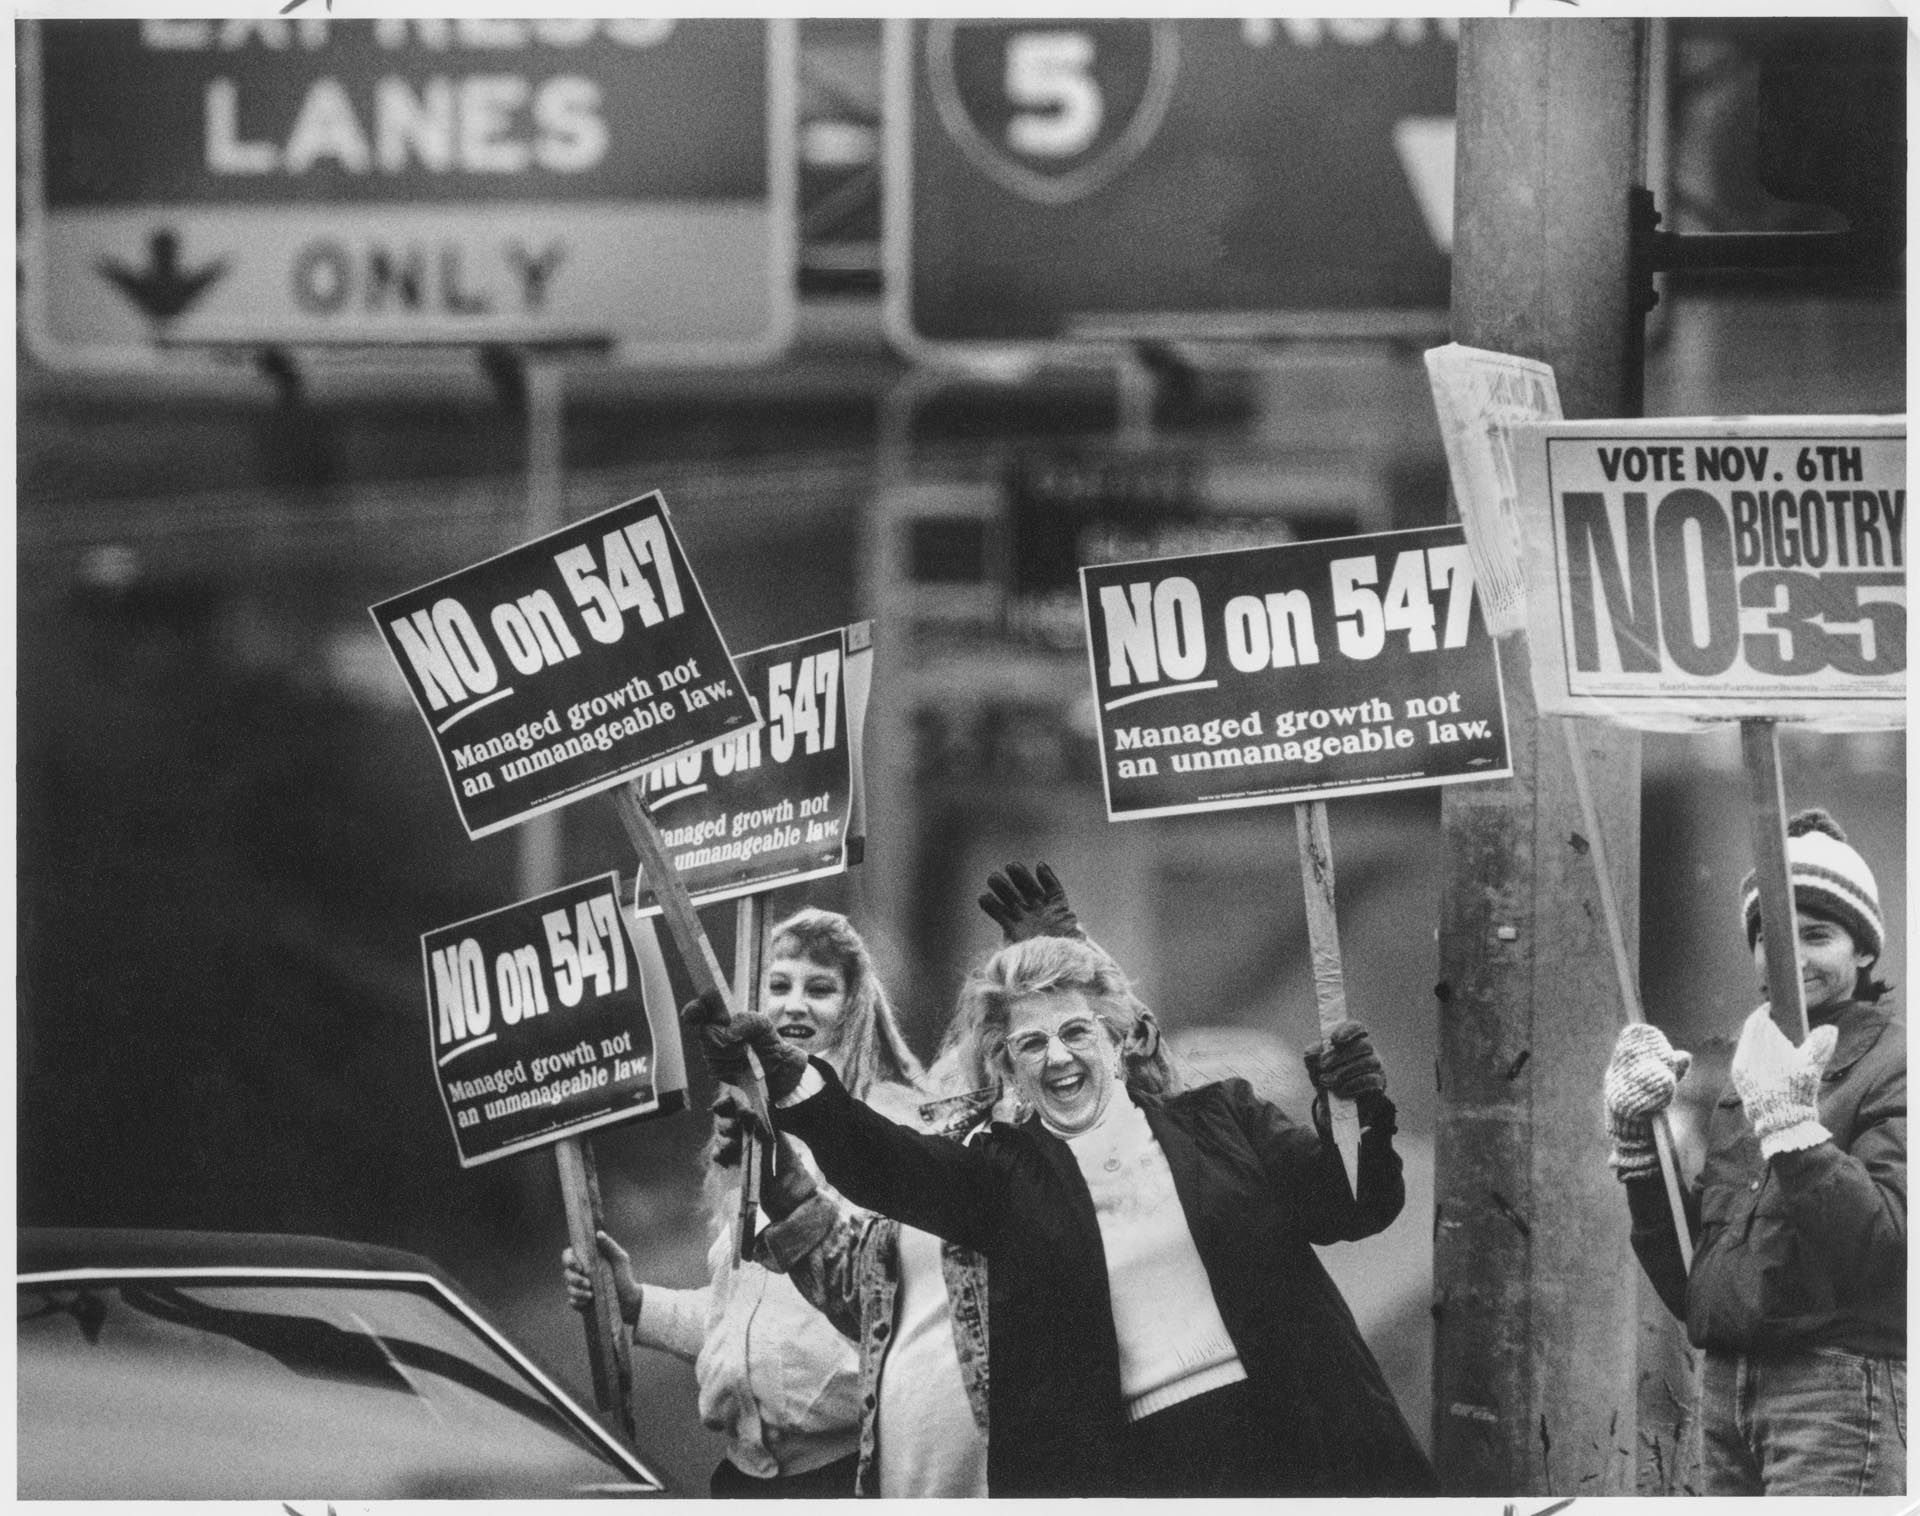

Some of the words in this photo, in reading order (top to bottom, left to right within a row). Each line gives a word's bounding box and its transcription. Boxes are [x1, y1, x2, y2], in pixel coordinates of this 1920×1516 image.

[205, 77, 609, 173] LANES
[1006, 32, 1101, 157] 5
[292, 237, 566, 316] ONLY
[1597, 446, 1686, 482] VOTE
[1695, 446, 1784, 482] NOV.
[1796, 446, 1863, 482] 6TH
[1731, 489, 1906, 568] BIGOTRY
[391, 598, 498, 711] NO
[491, 589, 581, 675] on
[554, 515, 685, 644] 547
[1100, 577, 1207, 686] NO
[1224, 589, 1320, 673] on
[1330, 544, 1475, 661] 547
[1562, 488, 1740, 677] NO
[1738, 570, 1907, 677] 35
[452, 710, 561, 771] Managed
[567, 677, 653, 731] growth
[658, 658, 701, 690] not
[462, 772, 494, 798] an
[500, 701, 675, 783] unmanageable
[680, 680, 733, 713] law.
[769, 649, 839, 763] 547
[1114, 711, 1263, 751] Managed
[1276, 697, 1394, 739] growth
[1405, 691, 1461, 720] not
[1118, 757, 1159, 779] an
[1170, 725, 1415, 774] unmanageable
[1426, 719, 1492, 745] law.
[660, 813, 727, 849] anaged
[732, 799, 794, 838] growth
[800, 792, 830, 818] not
[674, 825, 801, 872] unmanageable
[805, 818, 840, 843] law.
[432, 938, 491, 1045] NO
[496, 944, 549, 1025] on
[542, 893, 628, 1007] 547
[448, 1060, 527, 1103] Managed
[531, 1041, 596, 1083] growth
[601, 1030, 632, 1057] not
[457, 1108, 480, 1128] an
[485, 1066, 608, 1120] unmanageable
[614, 1055, 648, 1082] law.
